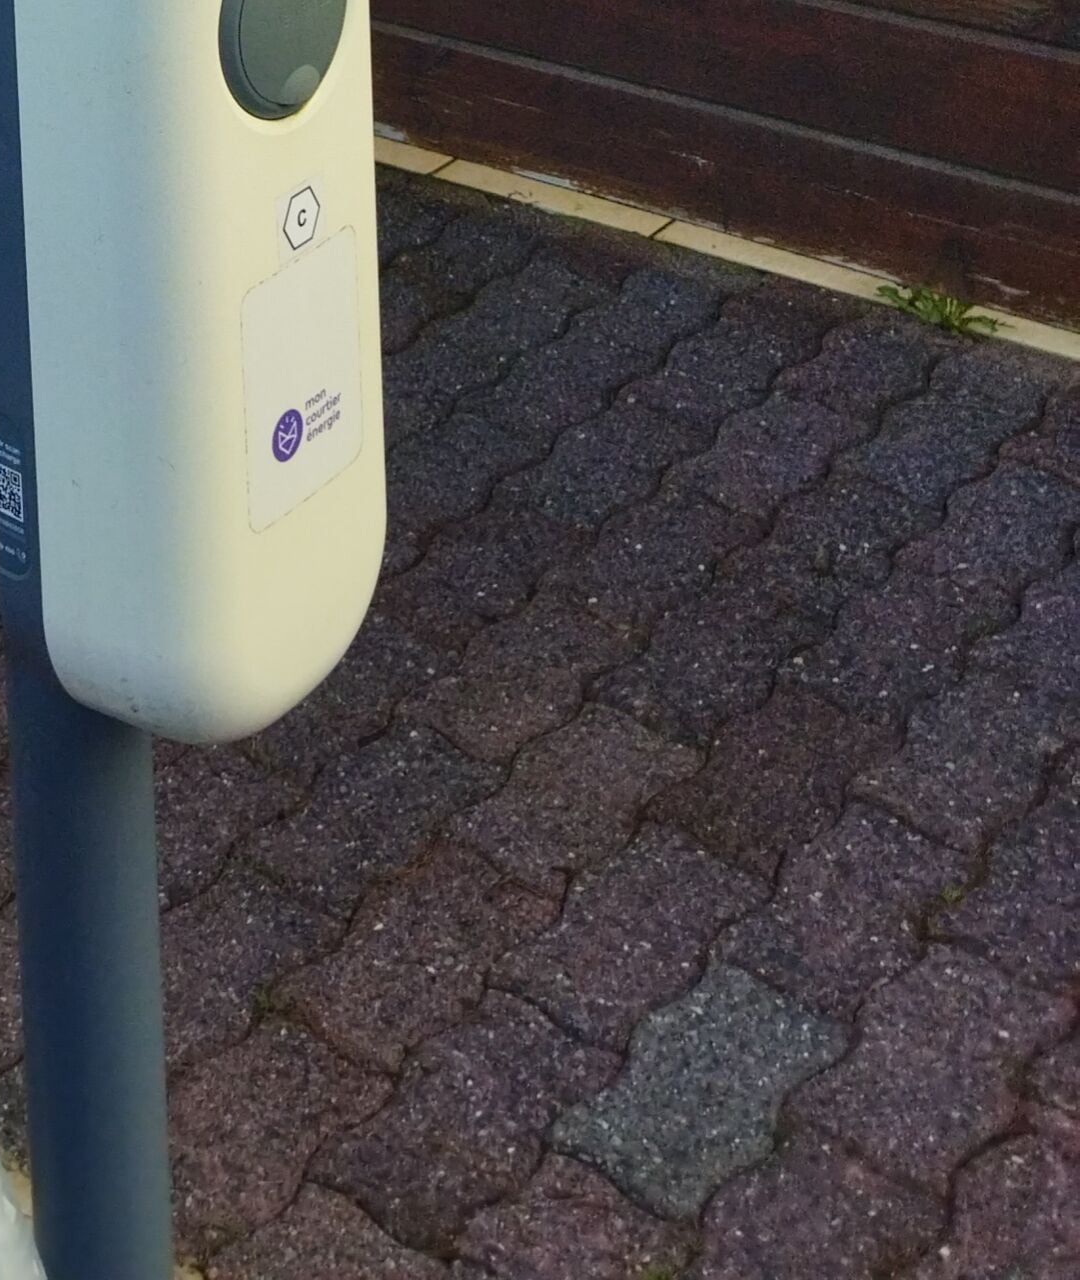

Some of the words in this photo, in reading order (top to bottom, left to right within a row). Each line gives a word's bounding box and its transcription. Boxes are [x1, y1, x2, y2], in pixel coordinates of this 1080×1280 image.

[297, 208, 307, 227] C
[305, 388, 327, 411] mon
[306, 391, 342, 426] courtier
[306, 410, 341, 442] énergie
